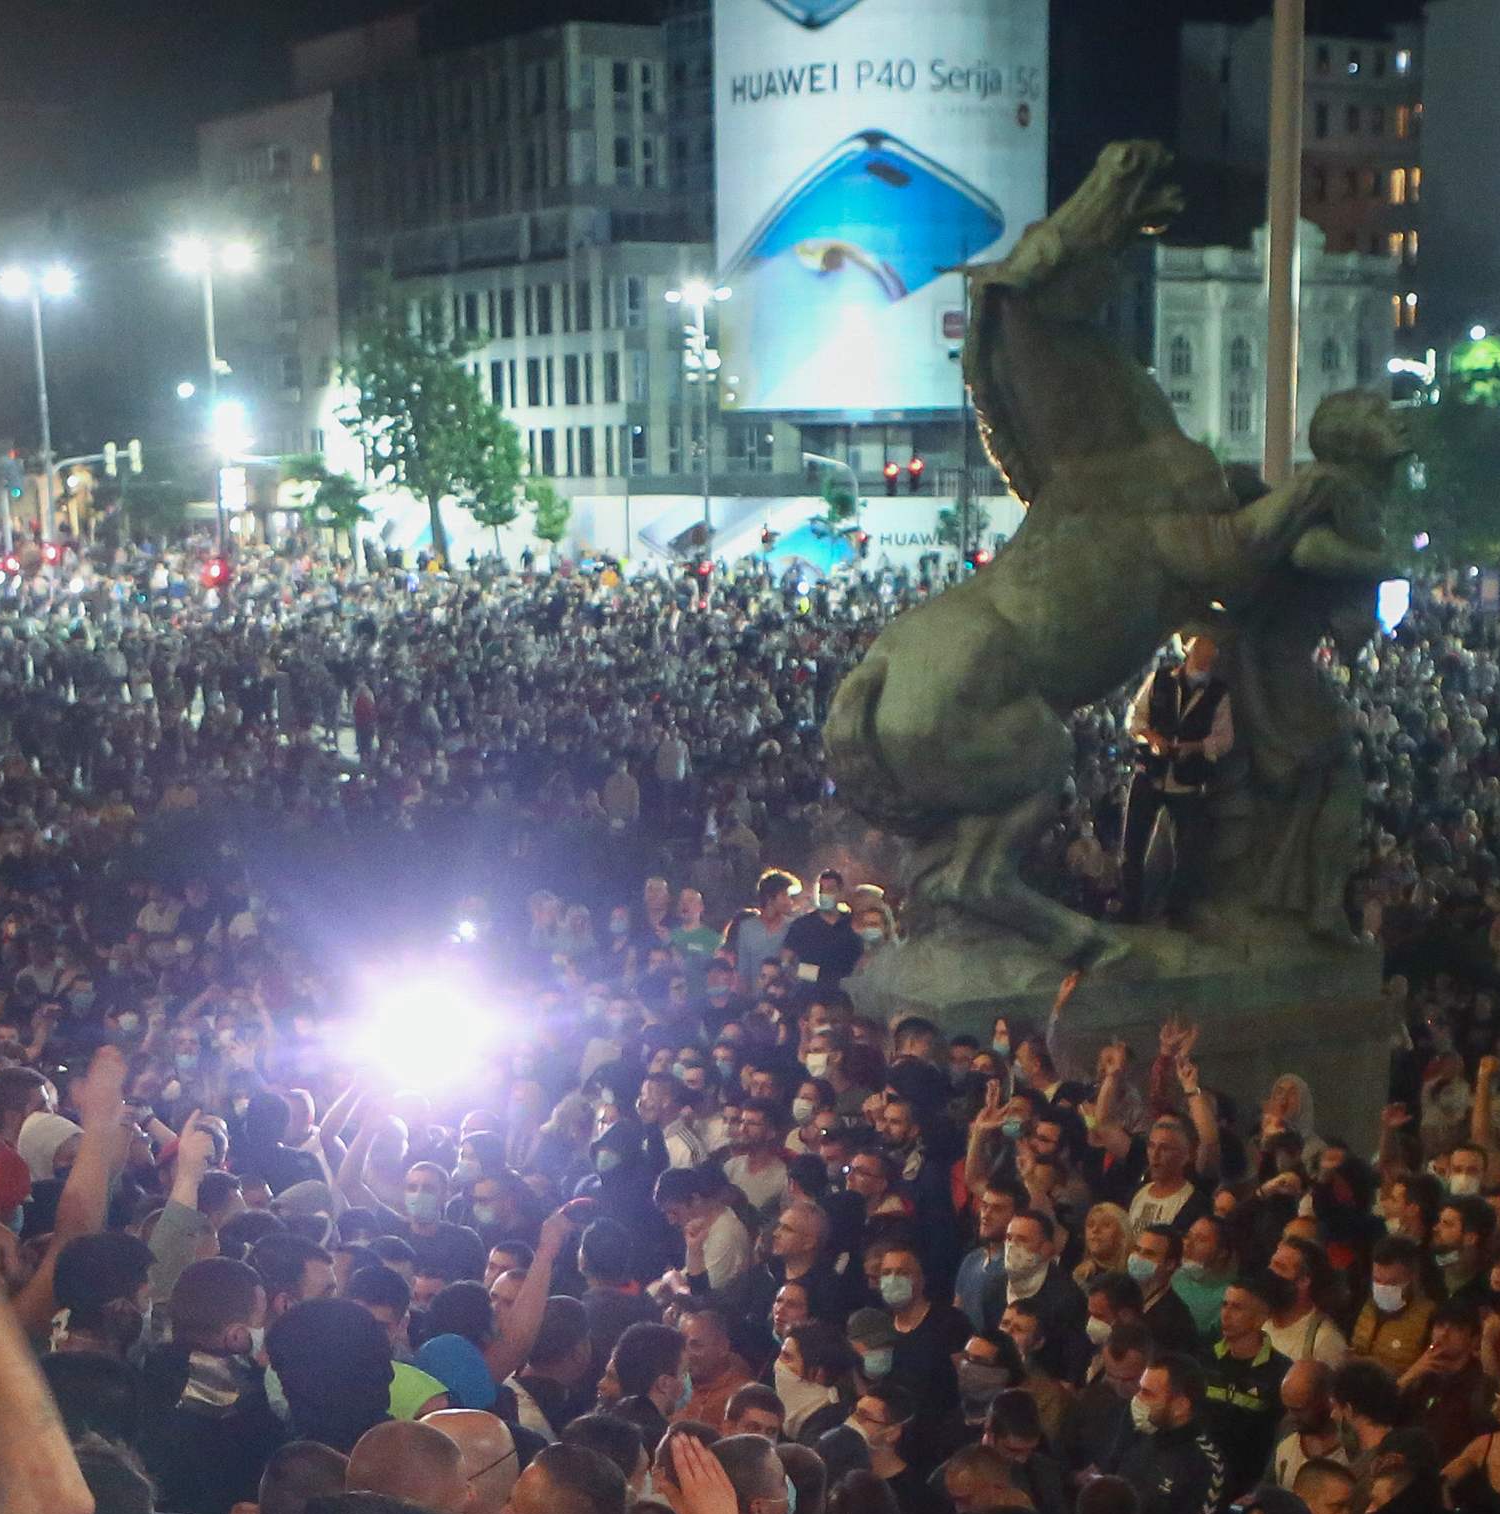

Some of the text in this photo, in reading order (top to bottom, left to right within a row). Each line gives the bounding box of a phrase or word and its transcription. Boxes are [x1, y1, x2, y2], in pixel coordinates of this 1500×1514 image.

[731, 61, 838, 102] HUAWEI
[857, 59, 917, 92] P40
[930, 58, 1001, 99] Serija
[880, 532, 949, 546] HUAW
